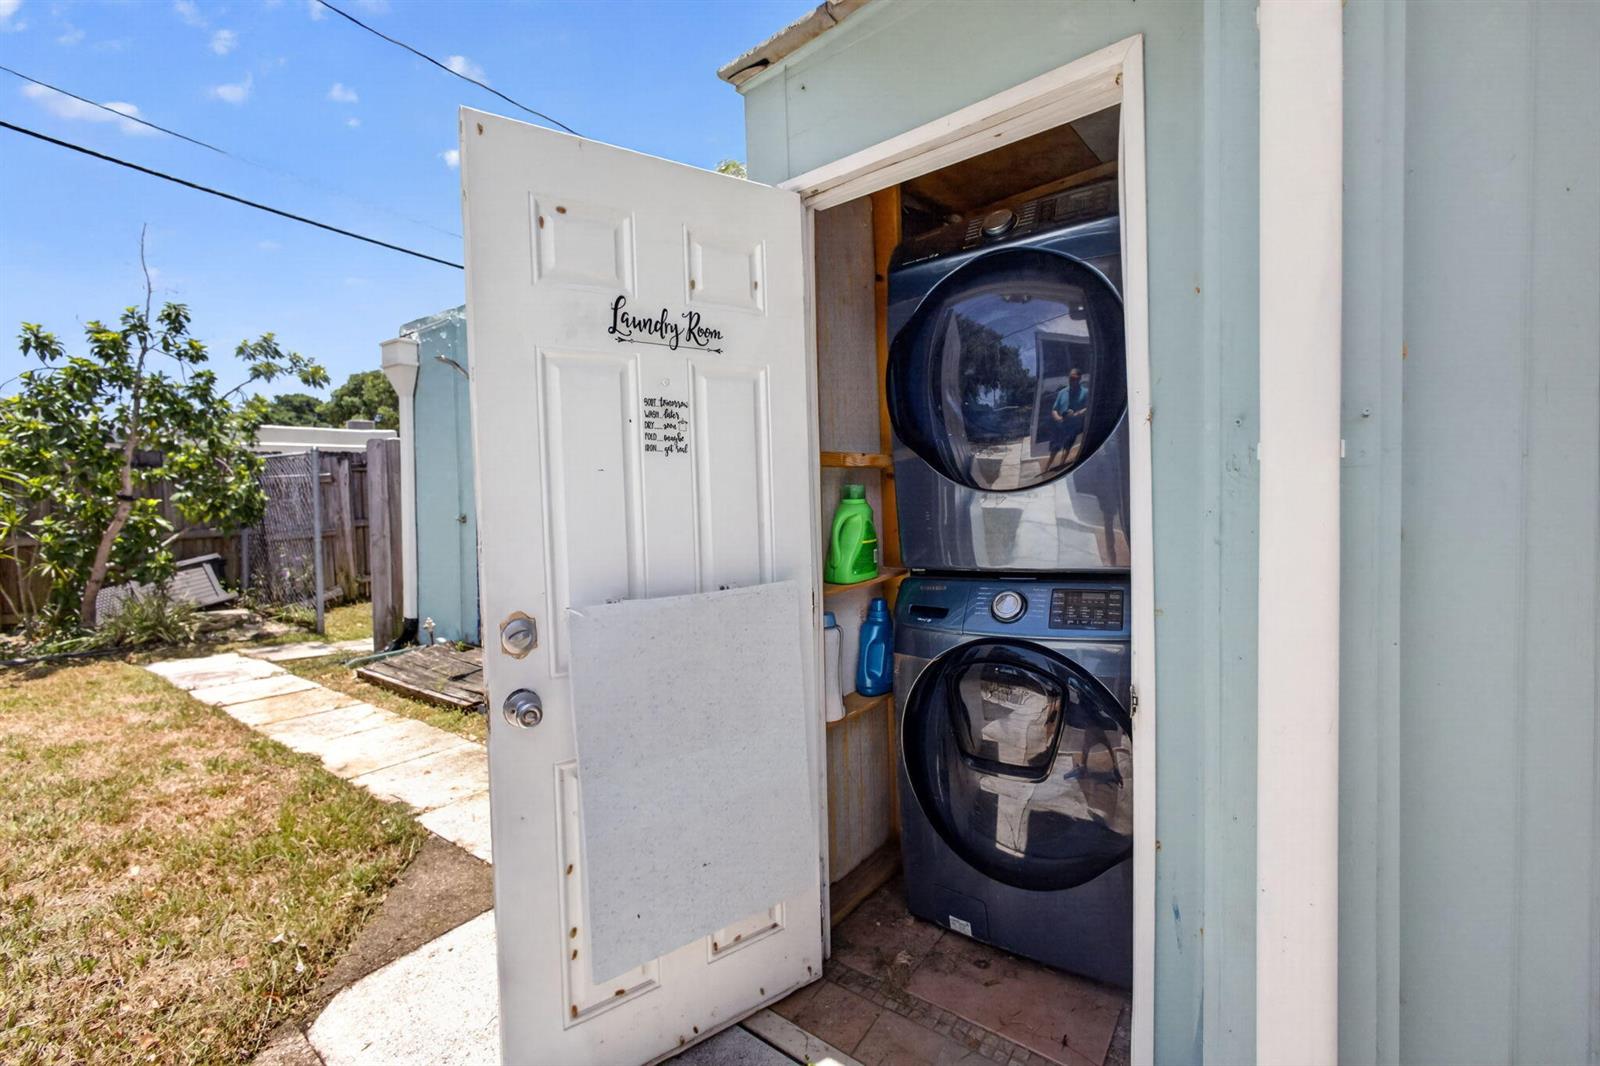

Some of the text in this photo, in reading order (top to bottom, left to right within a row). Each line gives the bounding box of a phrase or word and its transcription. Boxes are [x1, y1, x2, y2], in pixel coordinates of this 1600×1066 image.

[608, 295, 723, 350] Laundry Room
[644, 420, 655, 429] DRY
